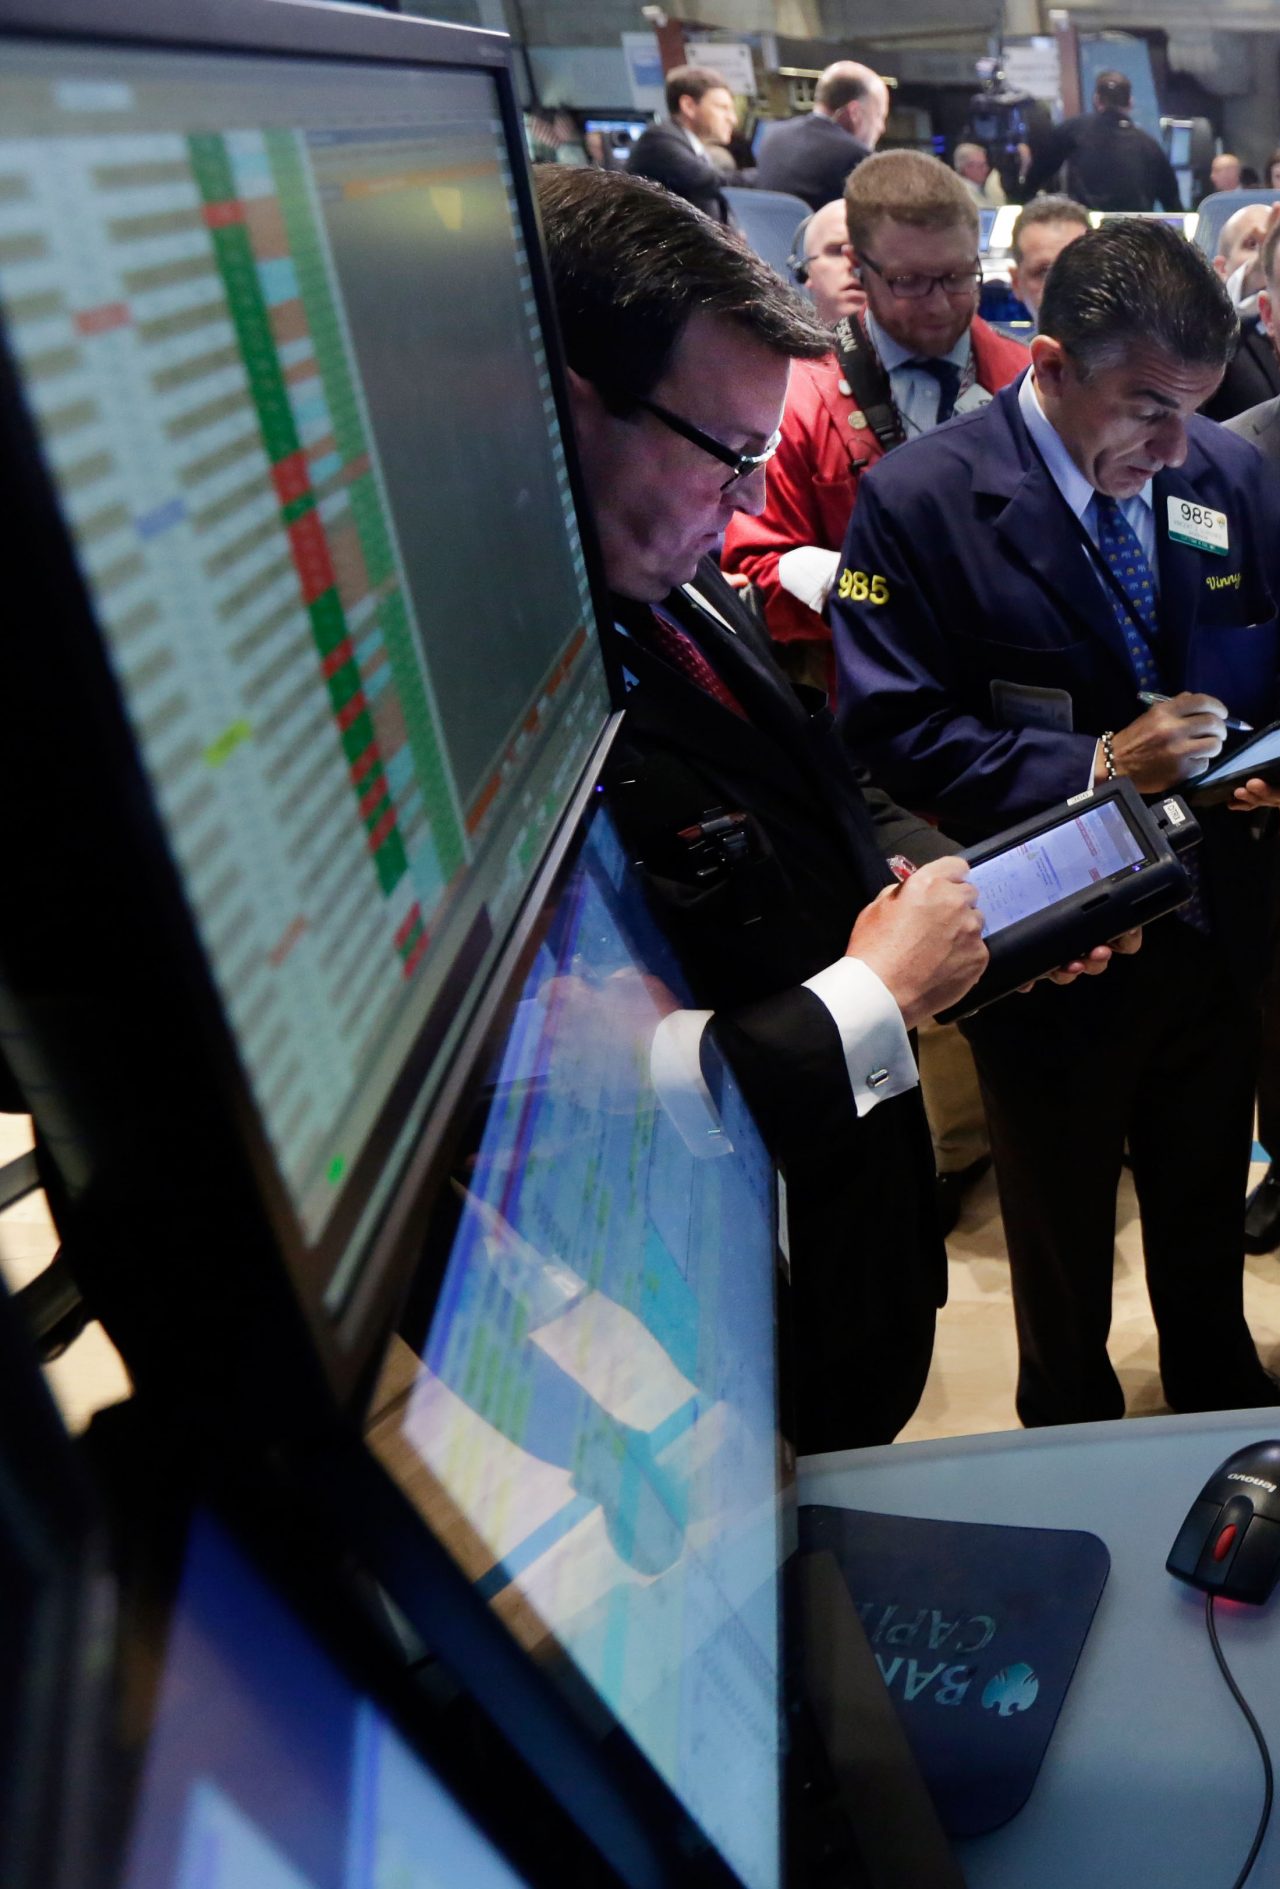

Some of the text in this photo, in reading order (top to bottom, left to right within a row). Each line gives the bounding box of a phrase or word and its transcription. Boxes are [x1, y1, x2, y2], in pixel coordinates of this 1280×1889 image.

[1181, 503, 1213, 528] 985
[838, 568, 889, 605] 985
[1205, 573, 1240, 590] Vinny
[1227, 1473, 1278, 1493] lenovo
